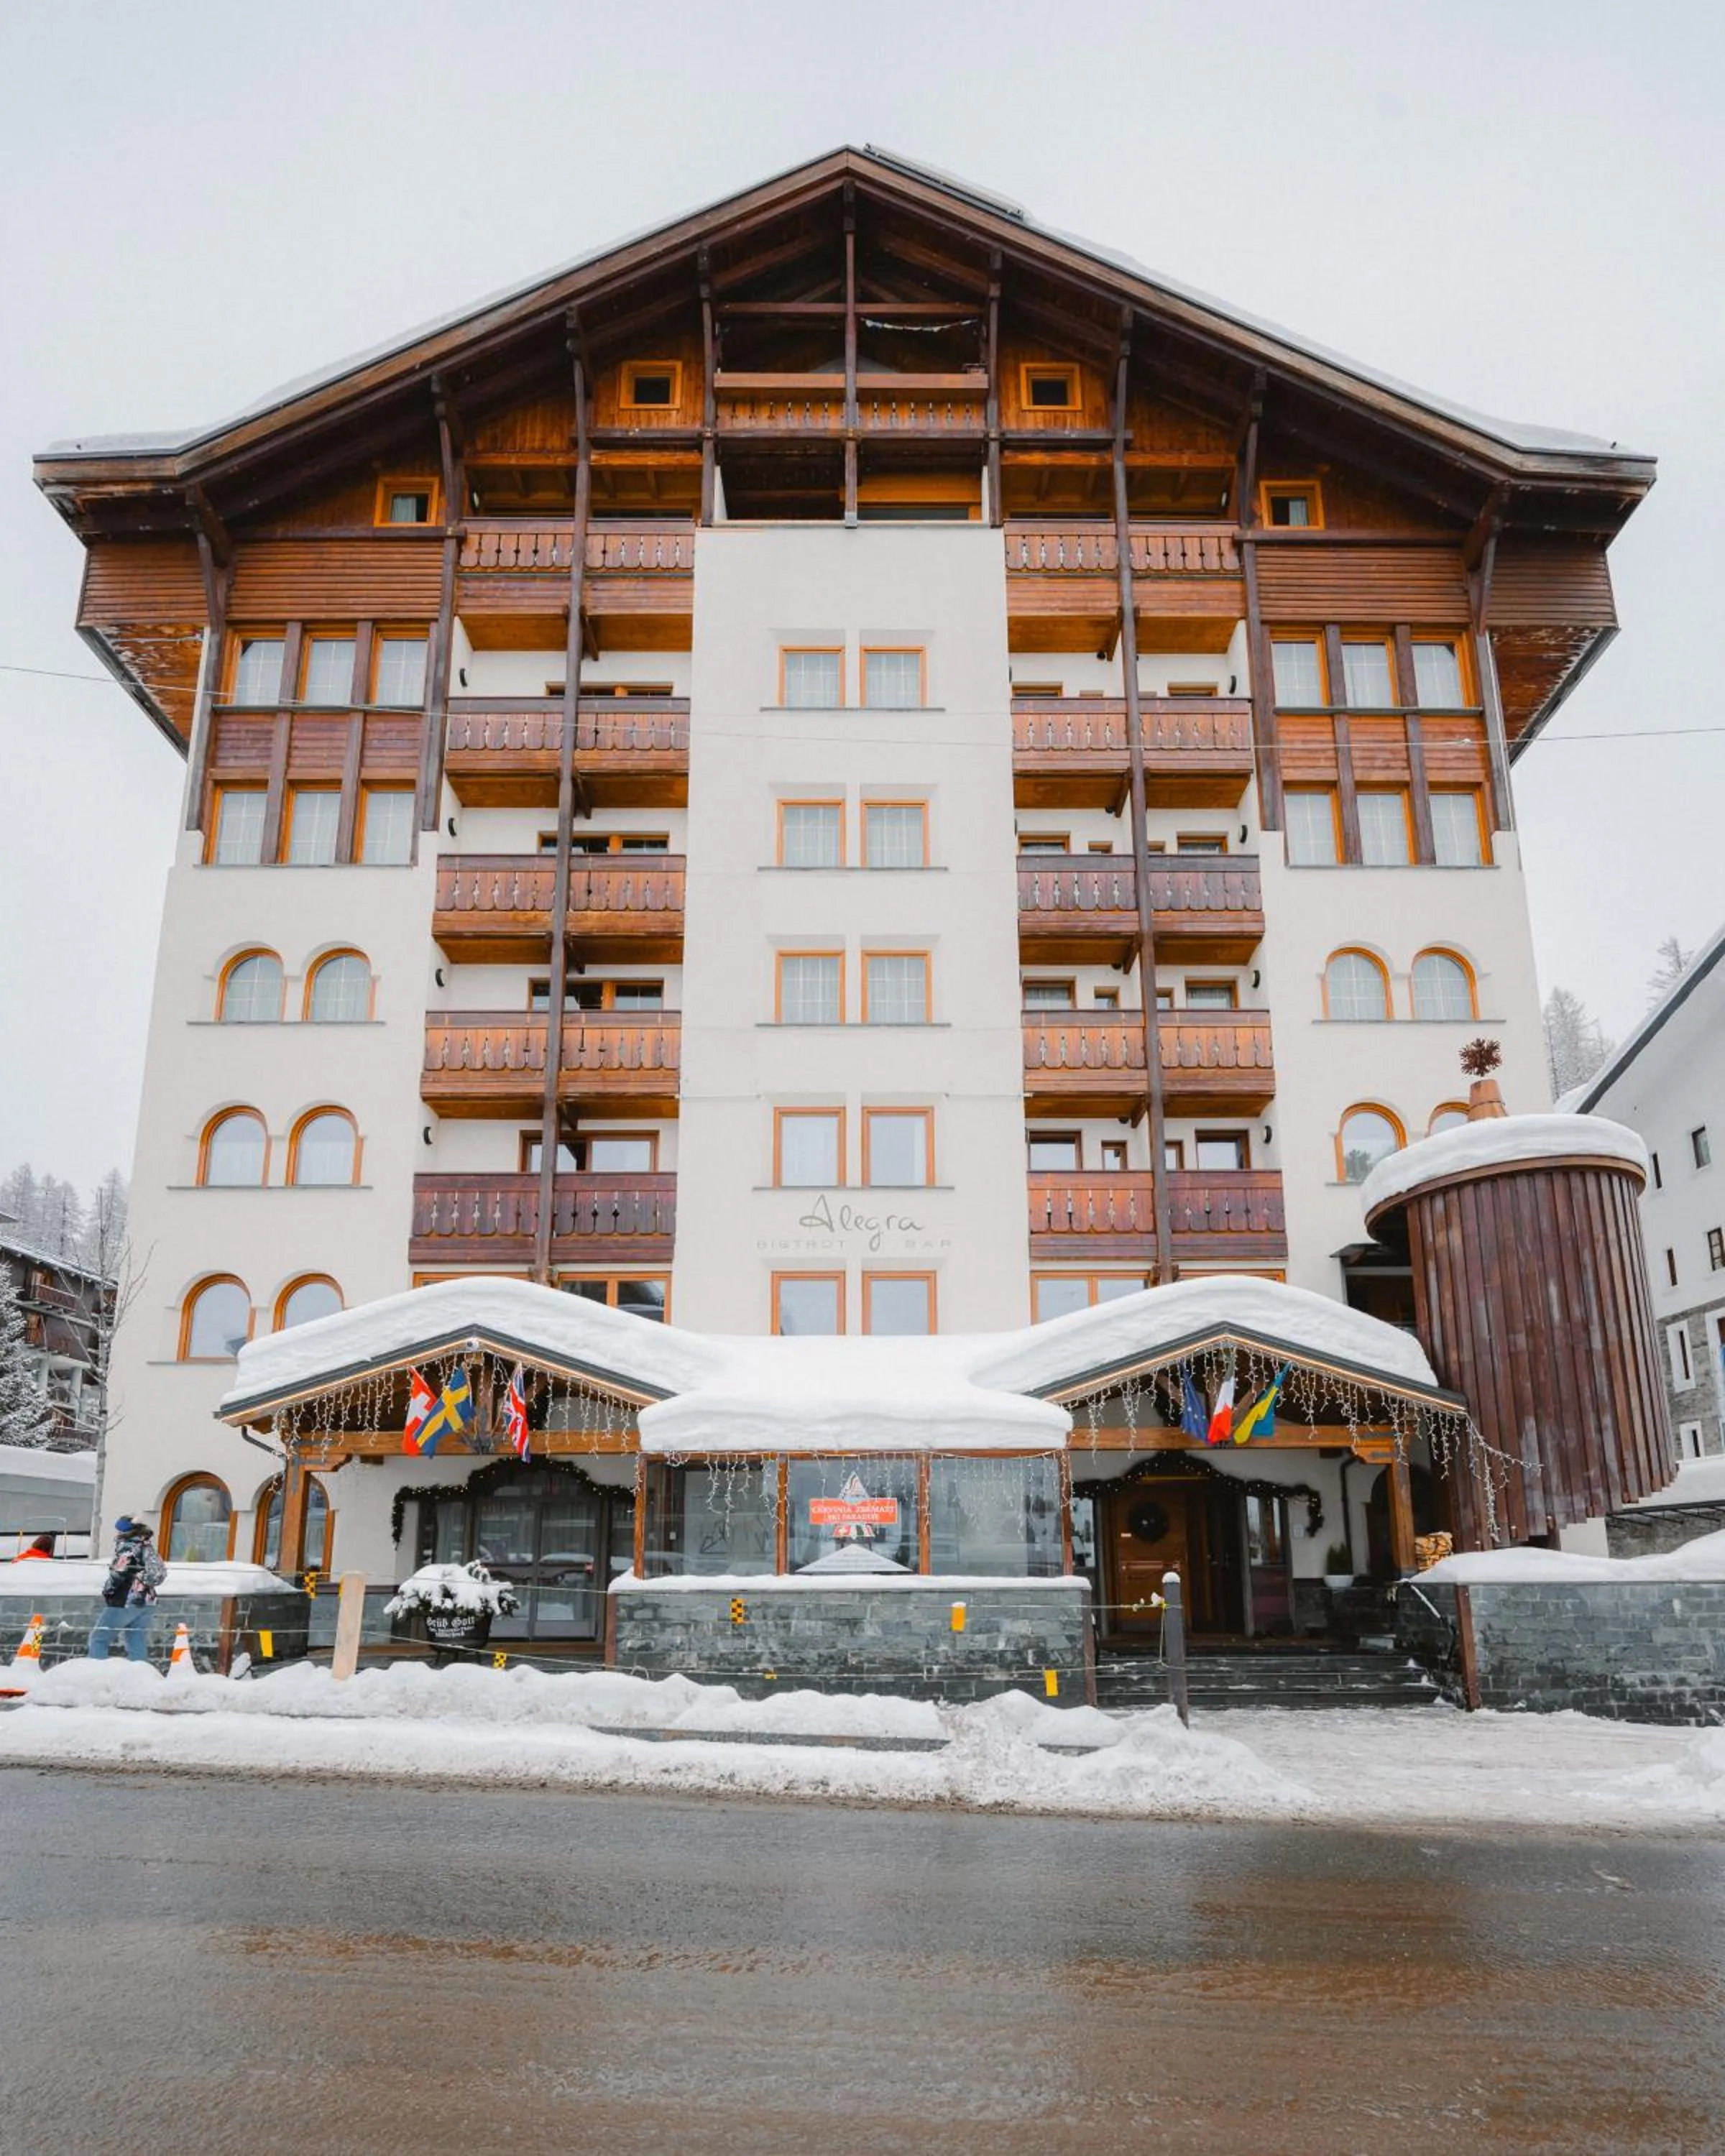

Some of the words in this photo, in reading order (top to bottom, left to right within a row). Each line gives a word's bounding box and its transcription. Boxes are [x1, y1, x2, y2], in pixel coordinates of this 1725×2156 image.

[799, 1194, 925, 1251] Alegra
[757, 1240, 847, 1249] BISTROT
[905, 1240, 952, 1249] BAR
